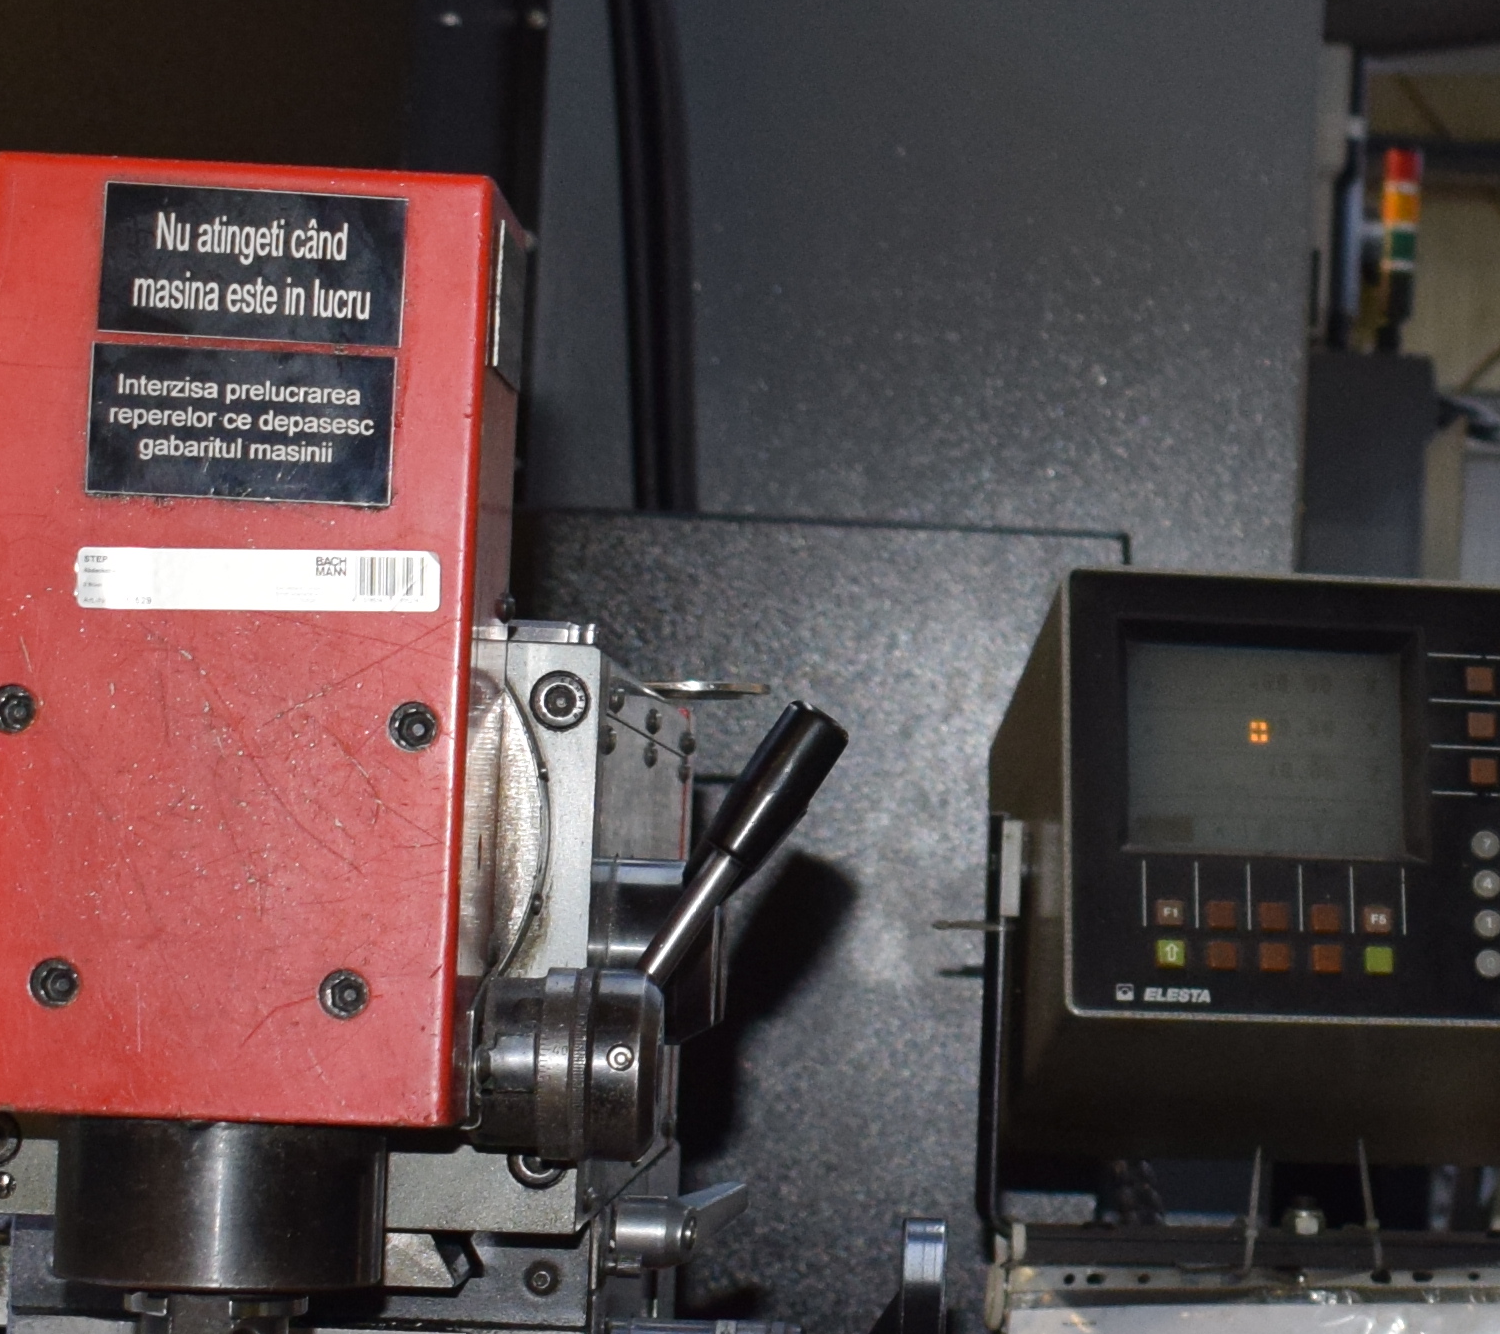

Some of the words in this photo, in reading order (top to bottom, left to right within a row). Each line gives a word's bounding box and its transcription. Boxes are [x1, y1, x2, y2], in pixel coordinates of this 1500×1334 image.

[156, 211, 190, 252] Nu
[197, 215, 285, 266] atingeti
[291, 218, 349, 261] când
[133, 271, 219, 311] masina
[226, 277, 278, 315] este
[285, 277, 305, 316] in
[313, 279, 371, 320] lucru
[117, 373, 218, 398] Interzisa
[225, 380, 361, 406] prelucrarea
[109, 406, 217, 430] reperelor
[222, 412, 252, 430] ce
[258, 410, 375, 437] depasesc
[138, 434, 243, 460] gabaritul
[249, 441, 333, 463] masinii
[83, 555, 108, 563] STEP
[315, 556, 347, 567] BACH
[315, 567, 347, 577] MANN
[1163, 907, 1179, 917] F1
[1143, 987, 1211, 1003] ELESTA
